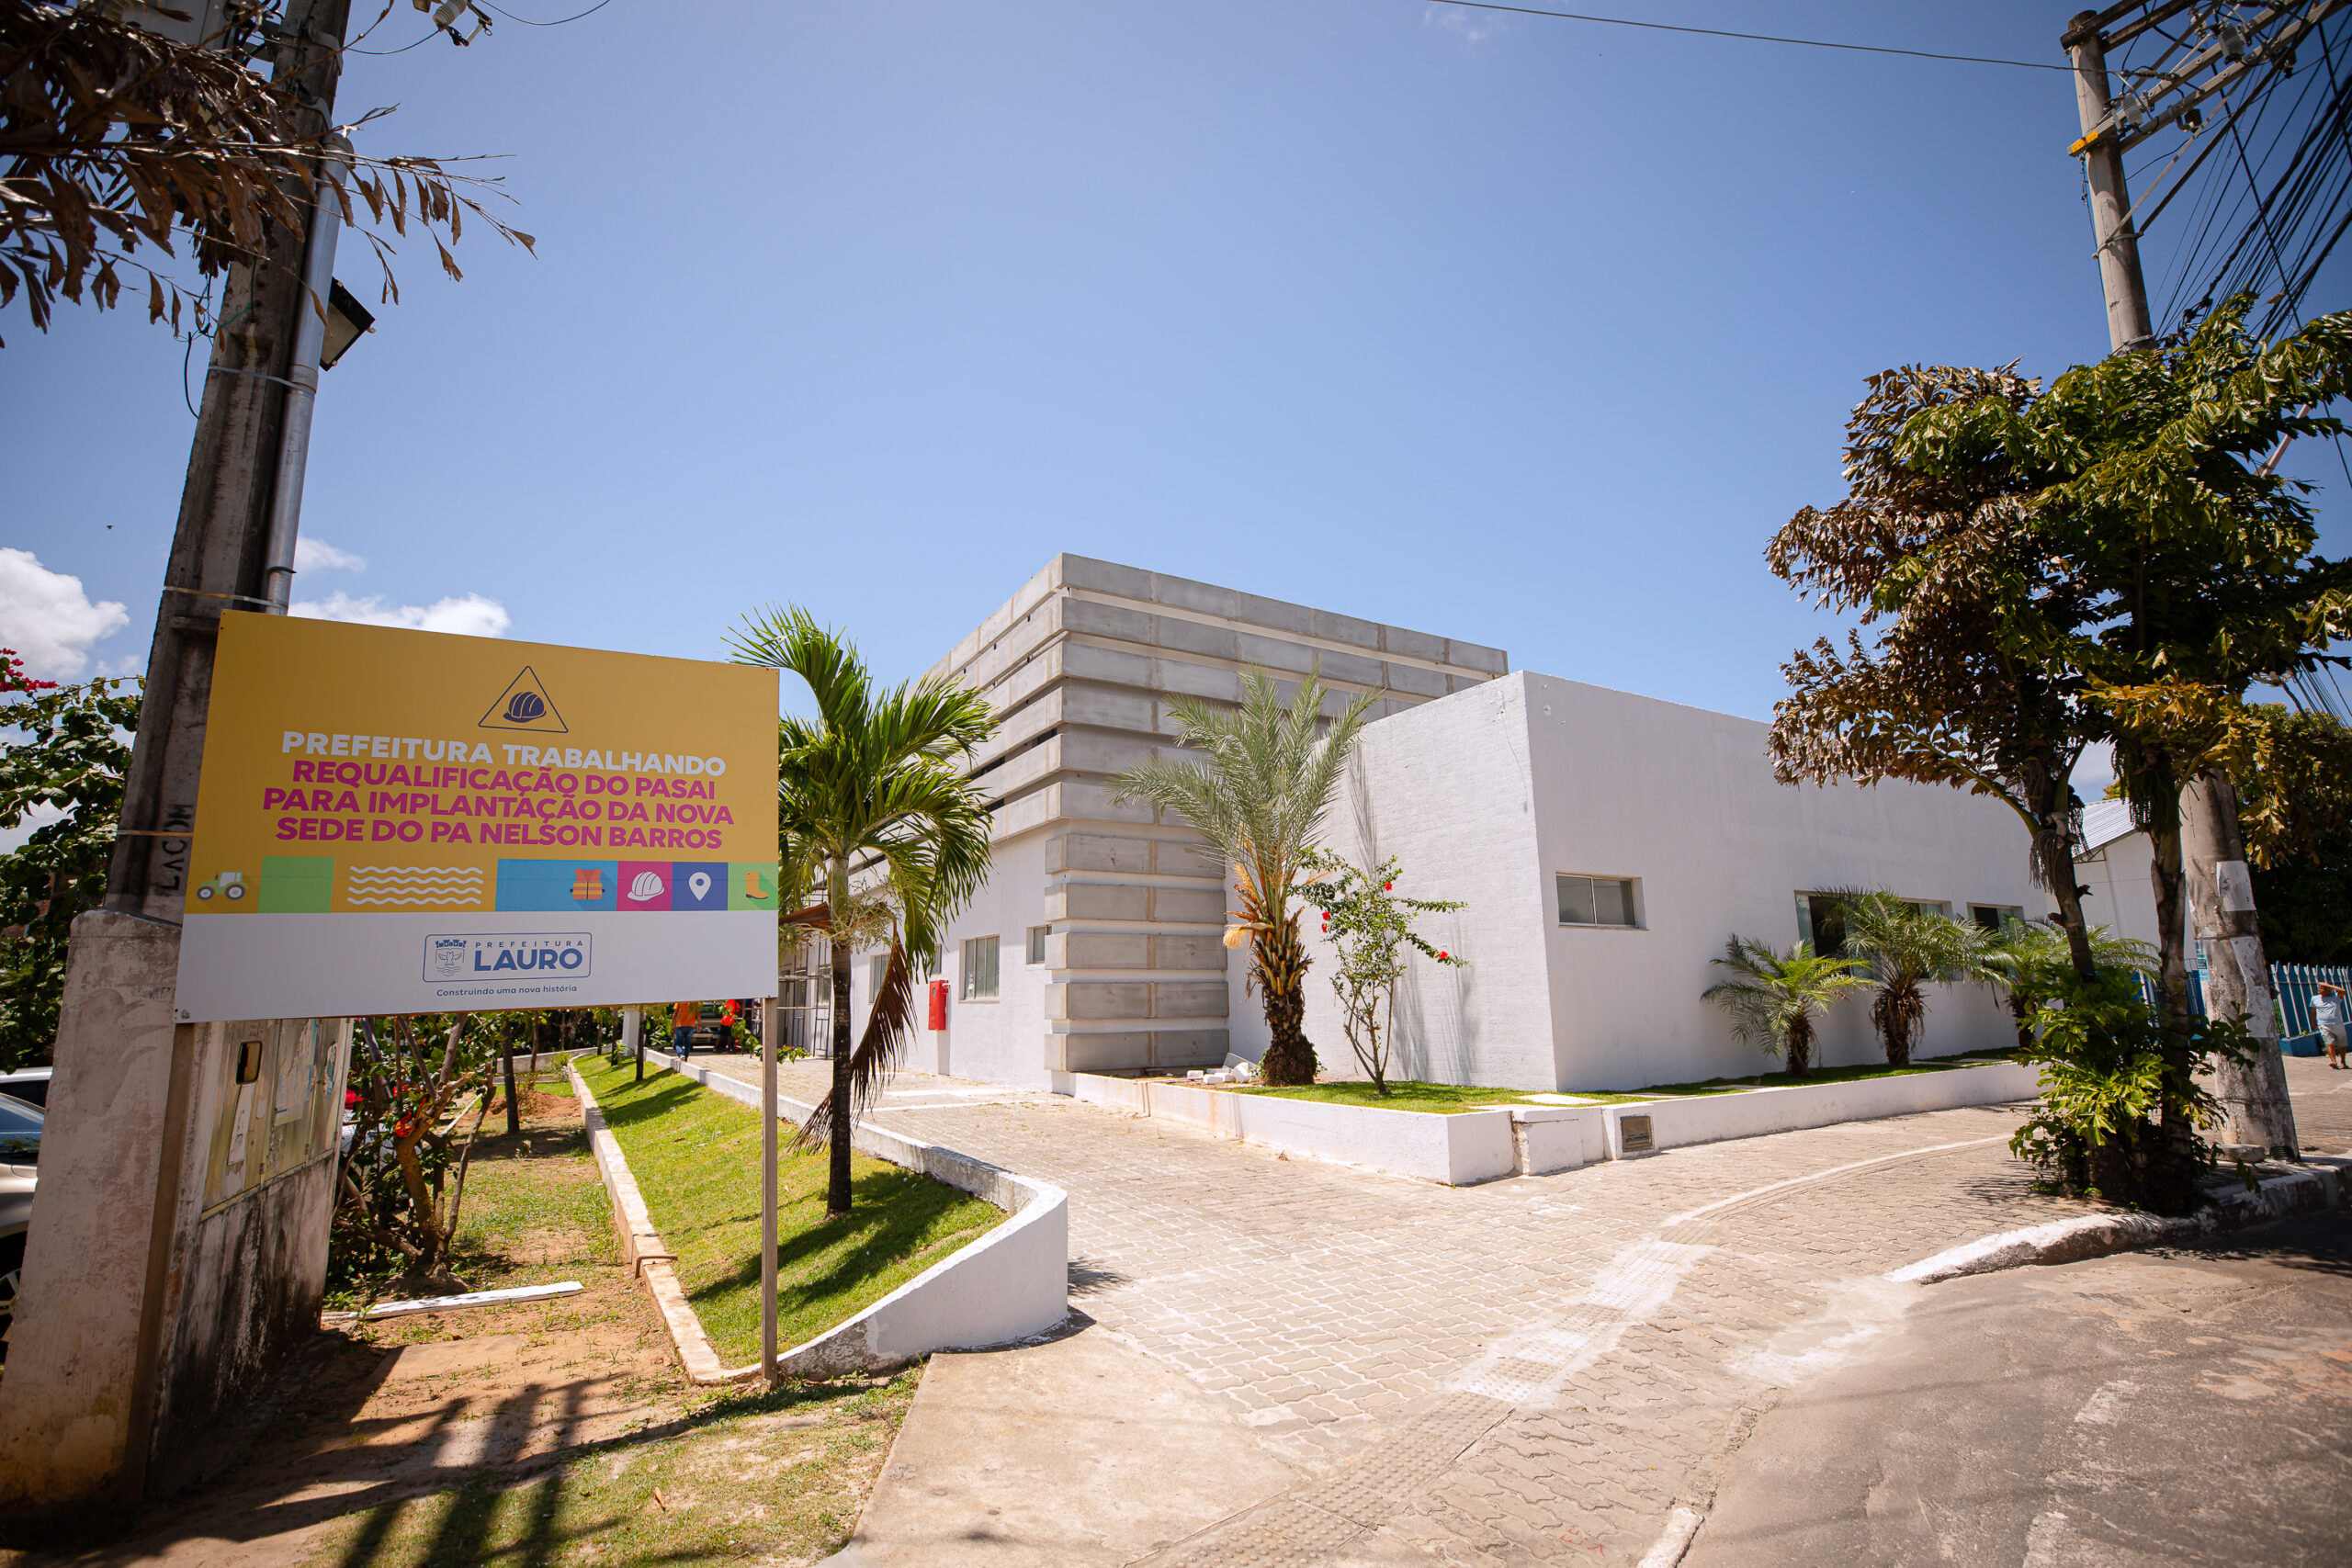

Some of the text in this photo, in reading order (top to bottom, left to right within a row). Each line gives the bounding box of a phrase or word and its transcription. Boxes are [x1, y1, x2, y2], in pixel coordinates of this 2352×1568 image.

[281, 730, 727, 776] PREFEITURA TRABALHANDO
[292, 760, 716, 800] REQUALIFICAÇÃO DO PASAI
[262, 787, 735, 825] PARA IMPLANTAÇÃO DA NOVA
[275, 817, 723, 850] SEDE DO PA NELSON BARROS
[473, 947, 583, 972] LAURO
[475, 940, 583, 949] PREFEITURA
[436, 987, 494, 998] Construindo
[543, 985, 578, 993] história
